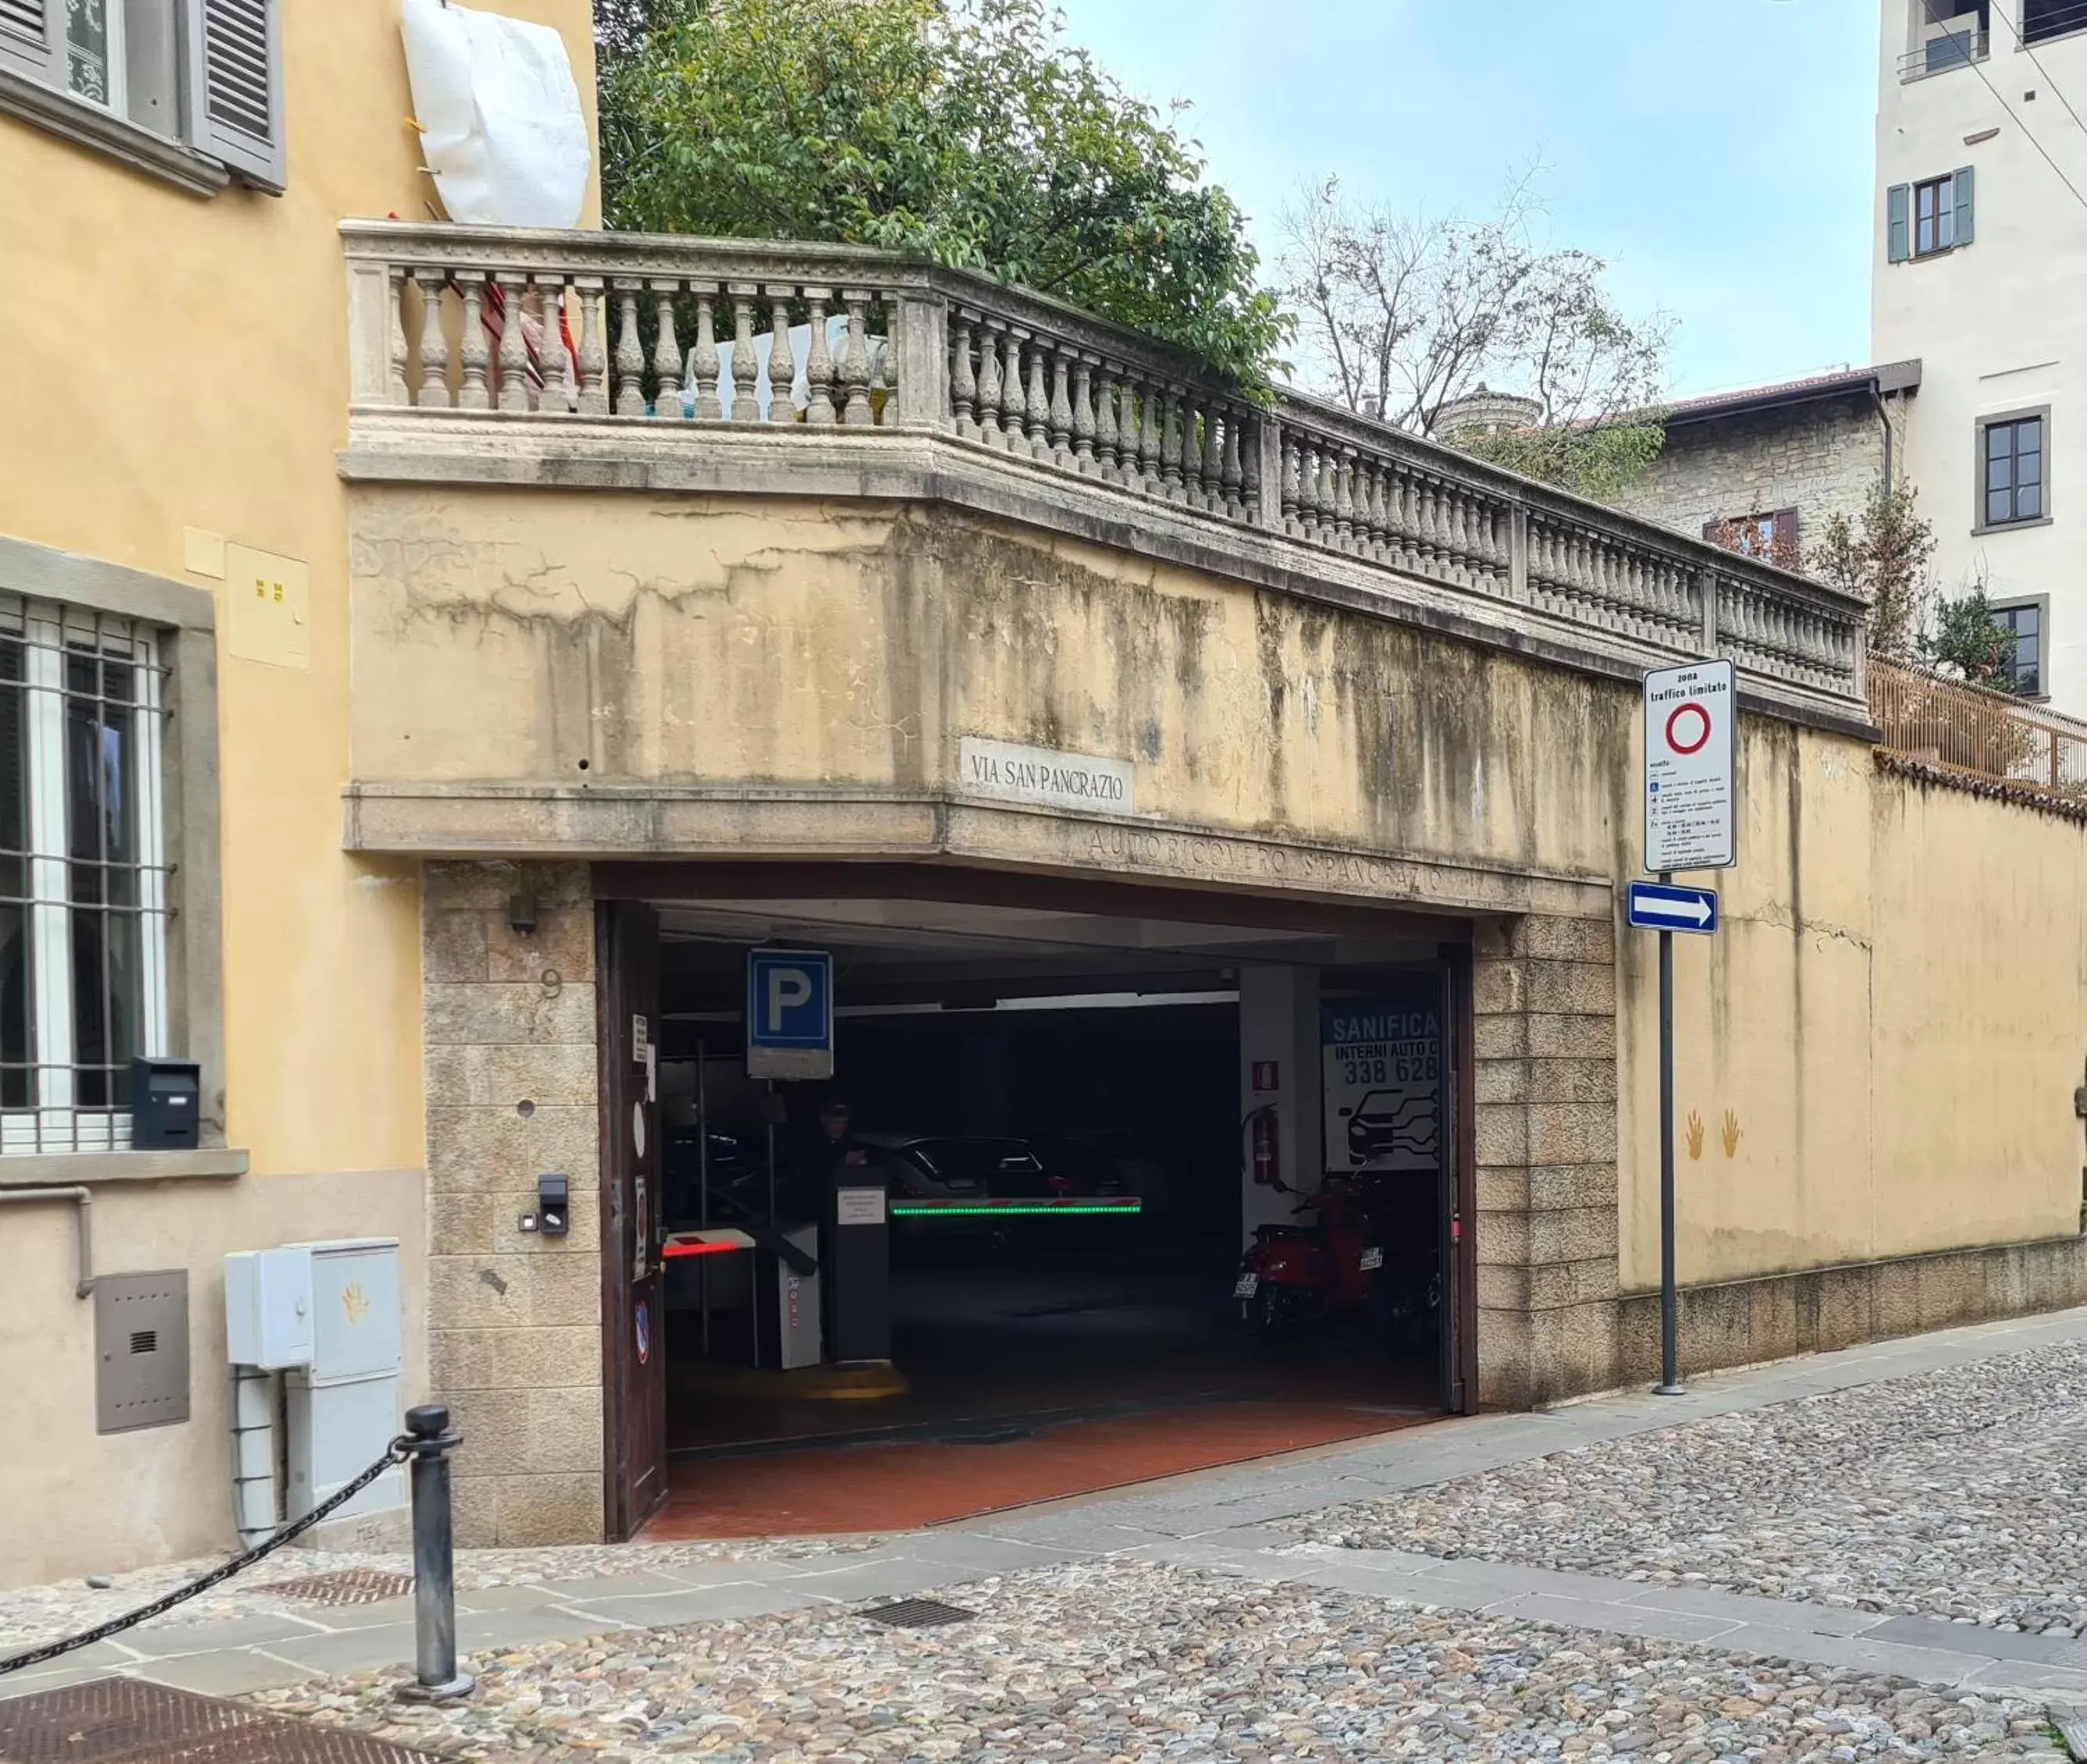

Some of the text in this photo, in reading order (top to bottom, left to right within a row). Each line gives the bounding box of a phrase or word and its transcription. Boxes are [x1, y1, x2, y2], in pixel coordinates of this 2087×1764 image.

[1651, 682, 1727, 702] traffico limitato
[1677, 673, 1698, 682] zona
[972, 754, 1123, 801] VIA SAN PANCRAZIO
[1090, 828, 1286, 872] AUTORICOVERO
[541, 968, 563, 1000] 9
[768, 968, 812, 1032] P
[1332, 1011, 1438, 1041] SANIFICA
[1336, 1043, 1387, 1061] INTERNI
[1391, 1041, 1425, 1057] AUTO
[1344, 1060, 1386, 1085] 338
